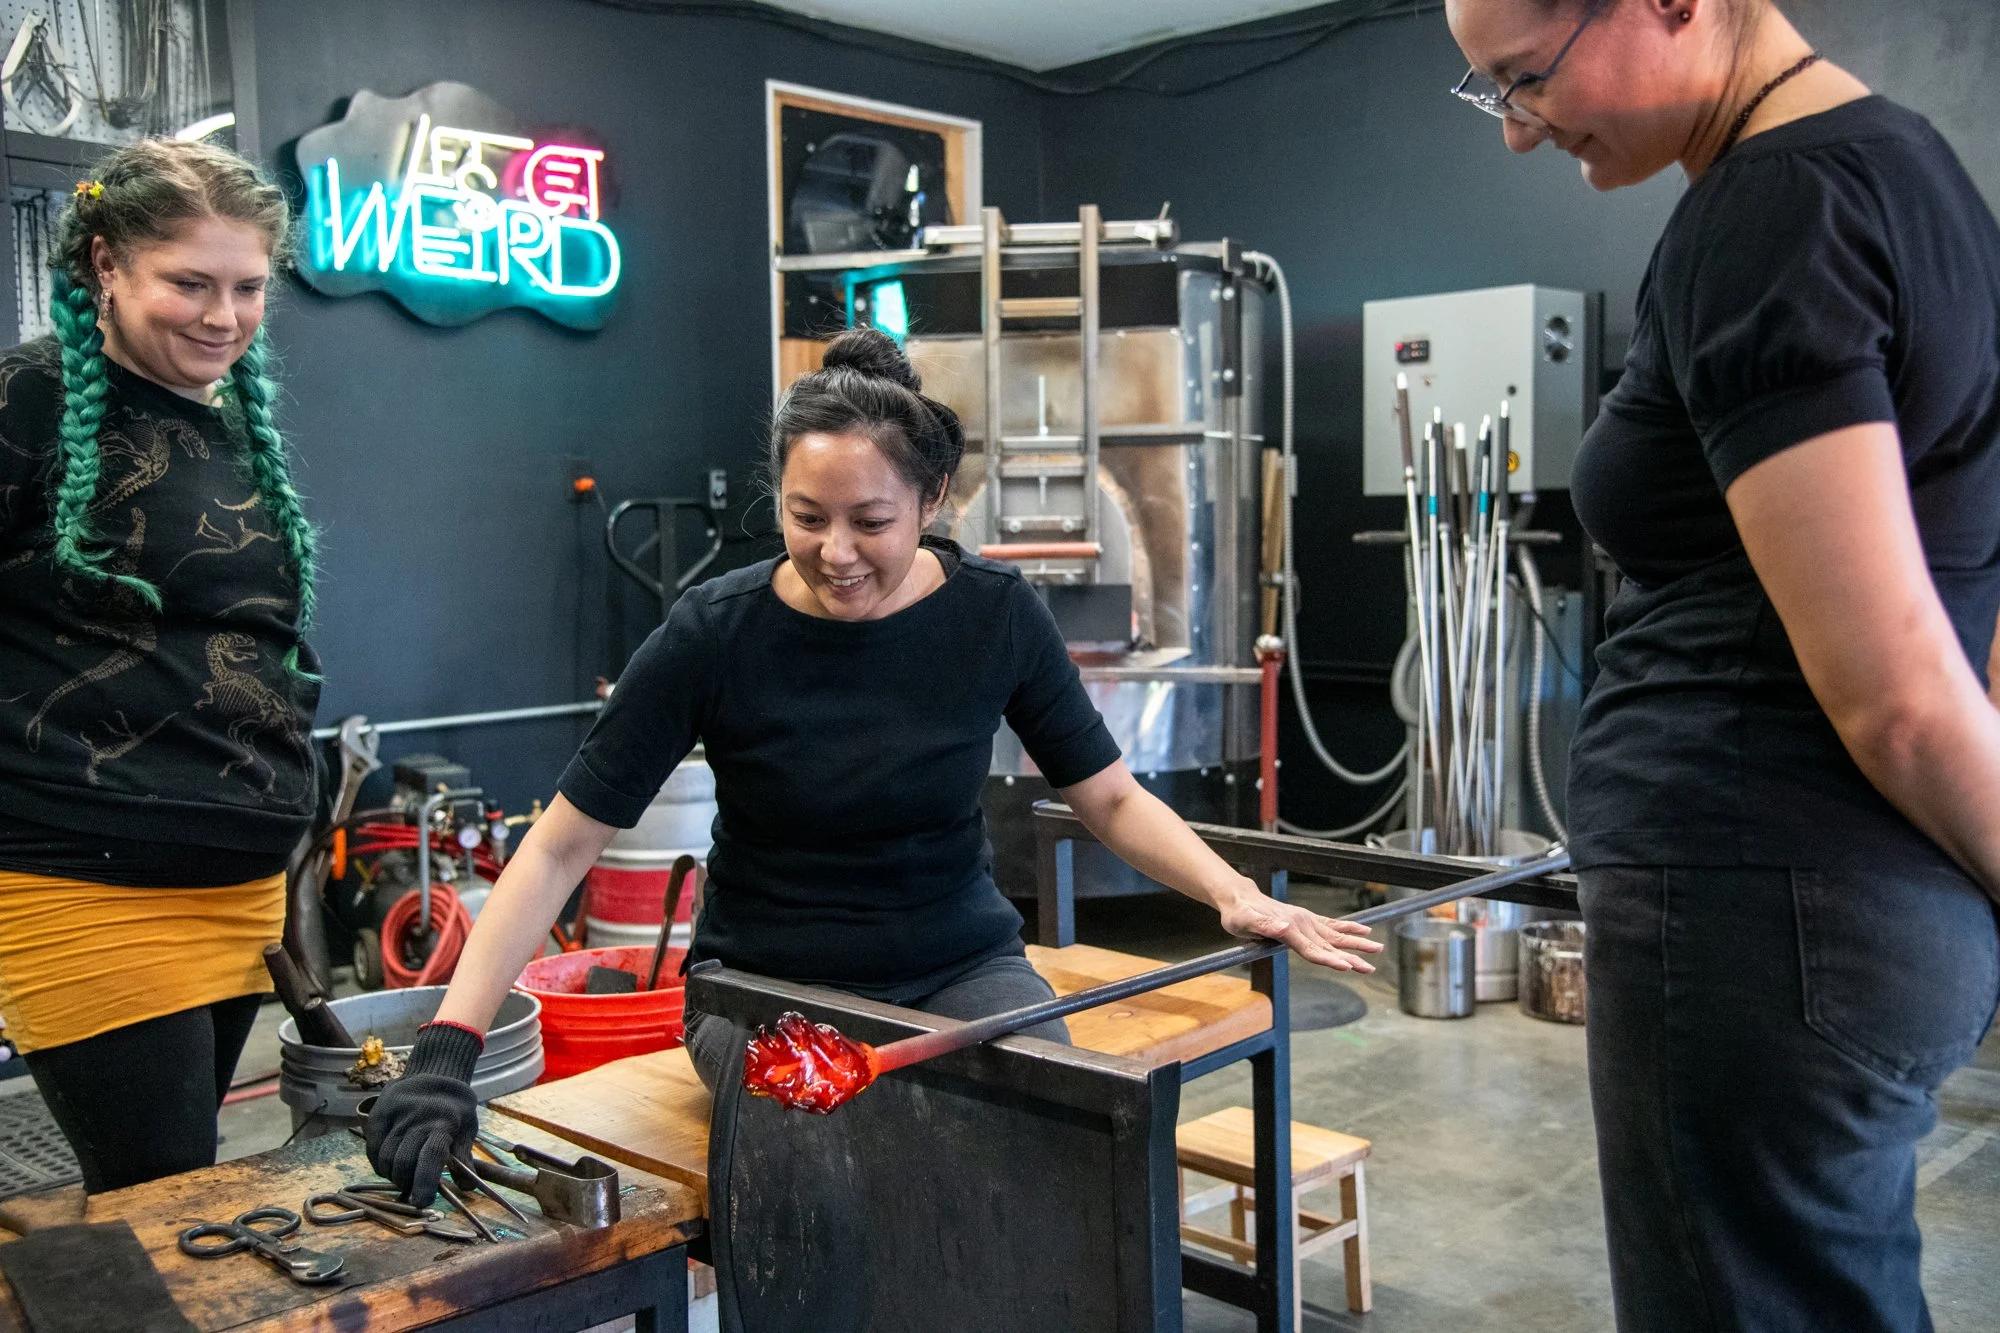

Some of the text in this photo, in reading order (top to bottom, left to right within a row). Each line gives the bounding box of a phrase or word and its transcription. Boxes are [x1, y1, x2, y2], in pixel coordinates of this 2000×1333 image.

[327, 157, 621, 297] WEIRD
[408, 113, 604, 231] LETS GET
